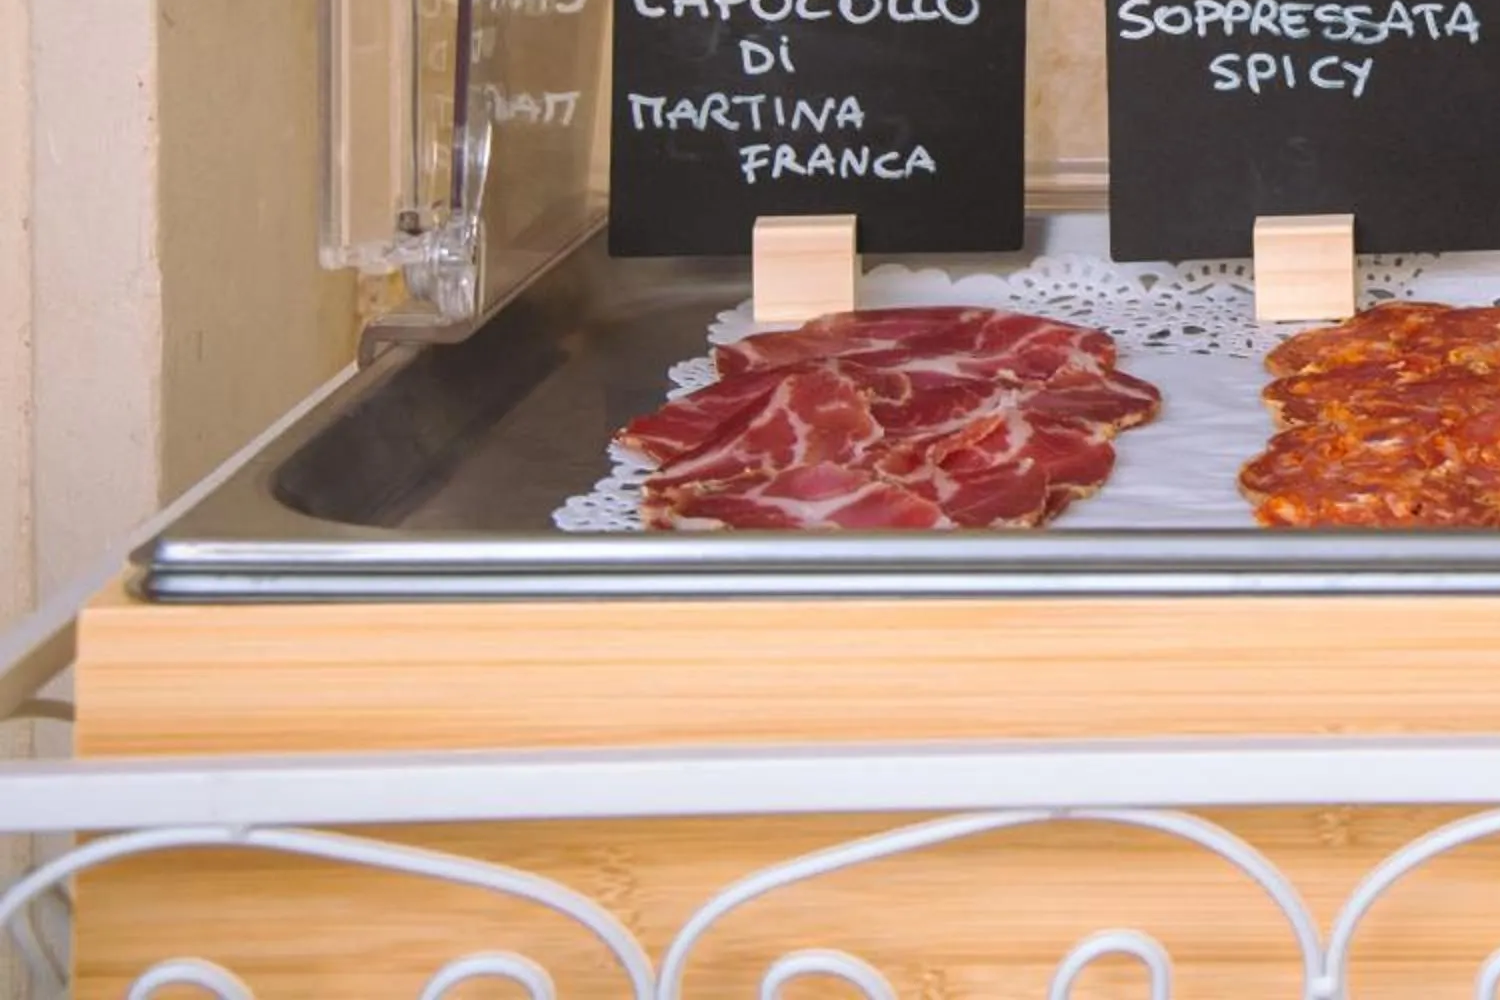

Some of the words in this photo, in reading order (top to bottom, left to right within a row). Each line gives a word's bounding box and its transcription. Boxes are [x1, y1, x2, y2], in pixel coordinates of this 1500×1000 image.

[1208, 52, 1374, 98] SPICY
[627, 92, 865, 133] MARTINA
[739, 143, 937, 184] FRANCA
